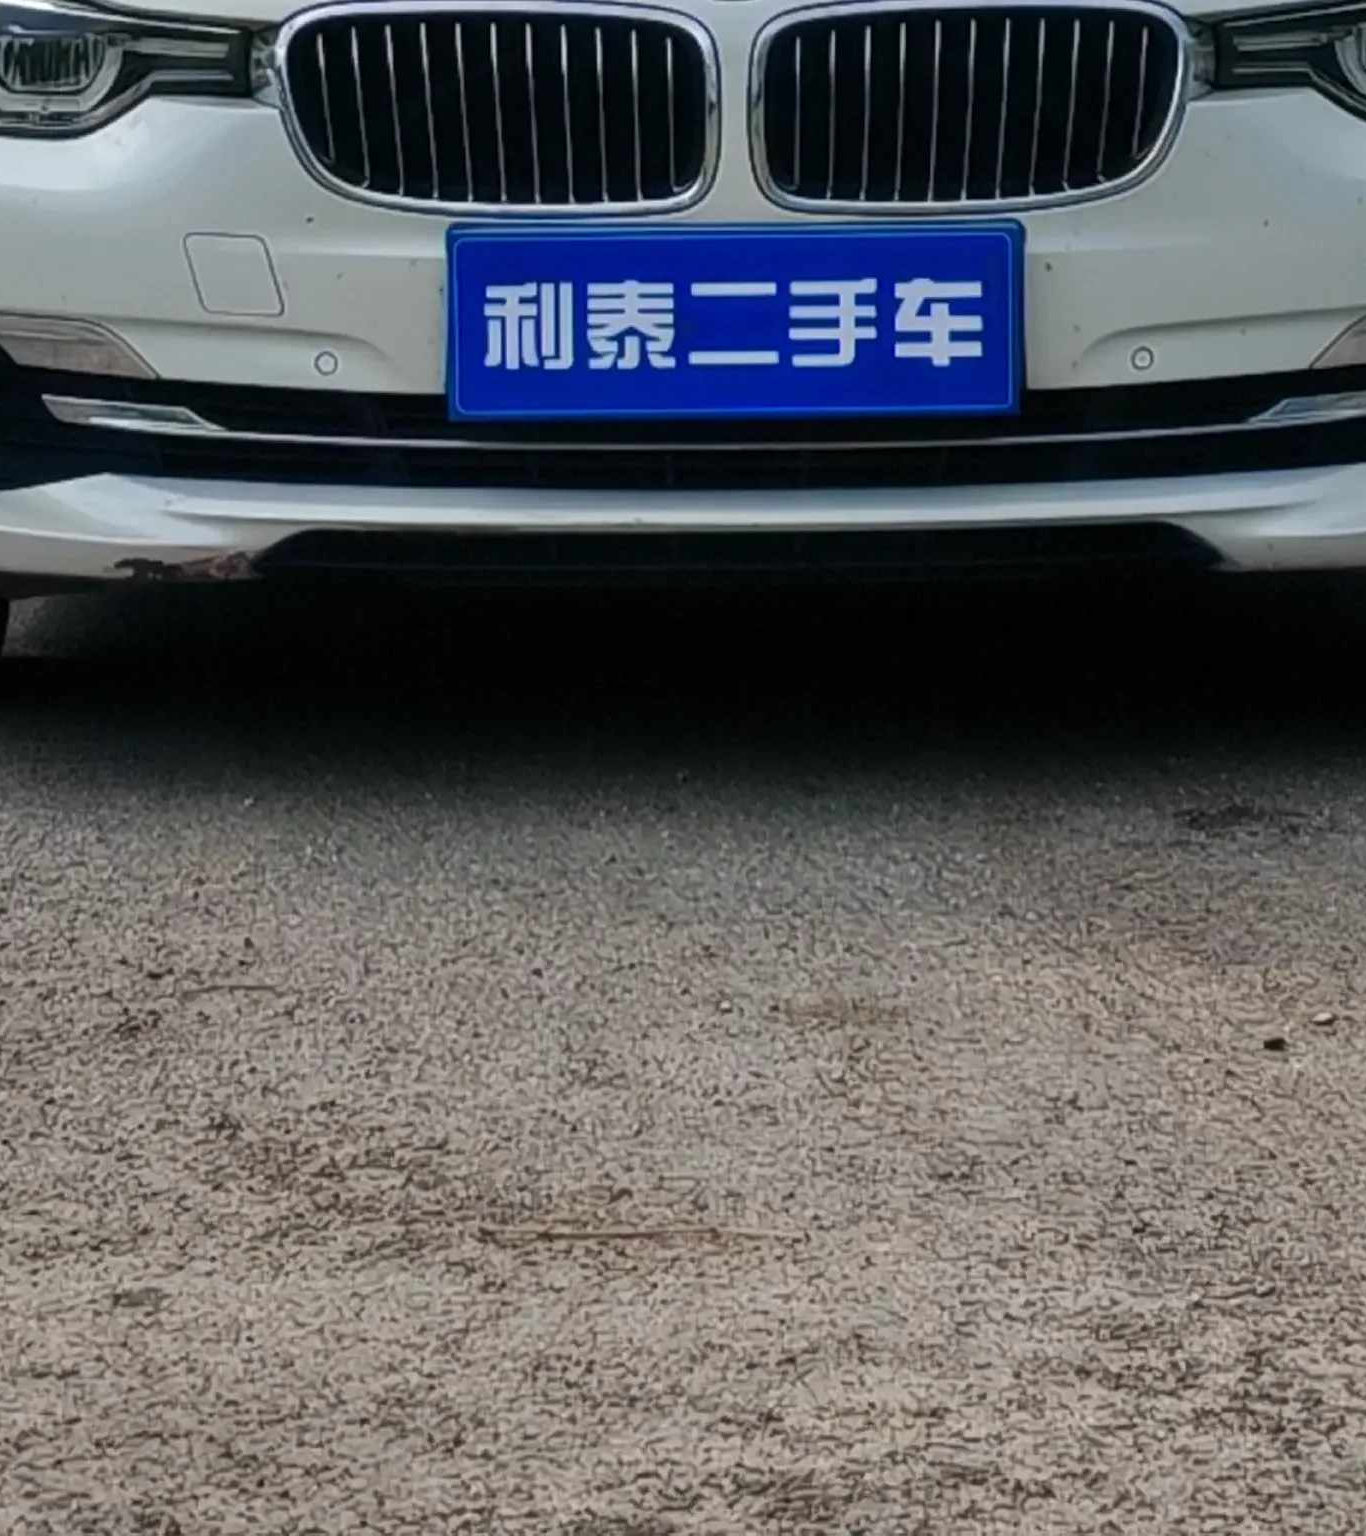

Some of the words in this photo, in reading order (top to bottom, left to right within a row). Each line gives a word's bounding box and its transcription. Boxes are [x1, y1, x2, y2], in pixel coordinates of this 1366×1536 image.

[483, 277, 984, 370] 利泰二手车
